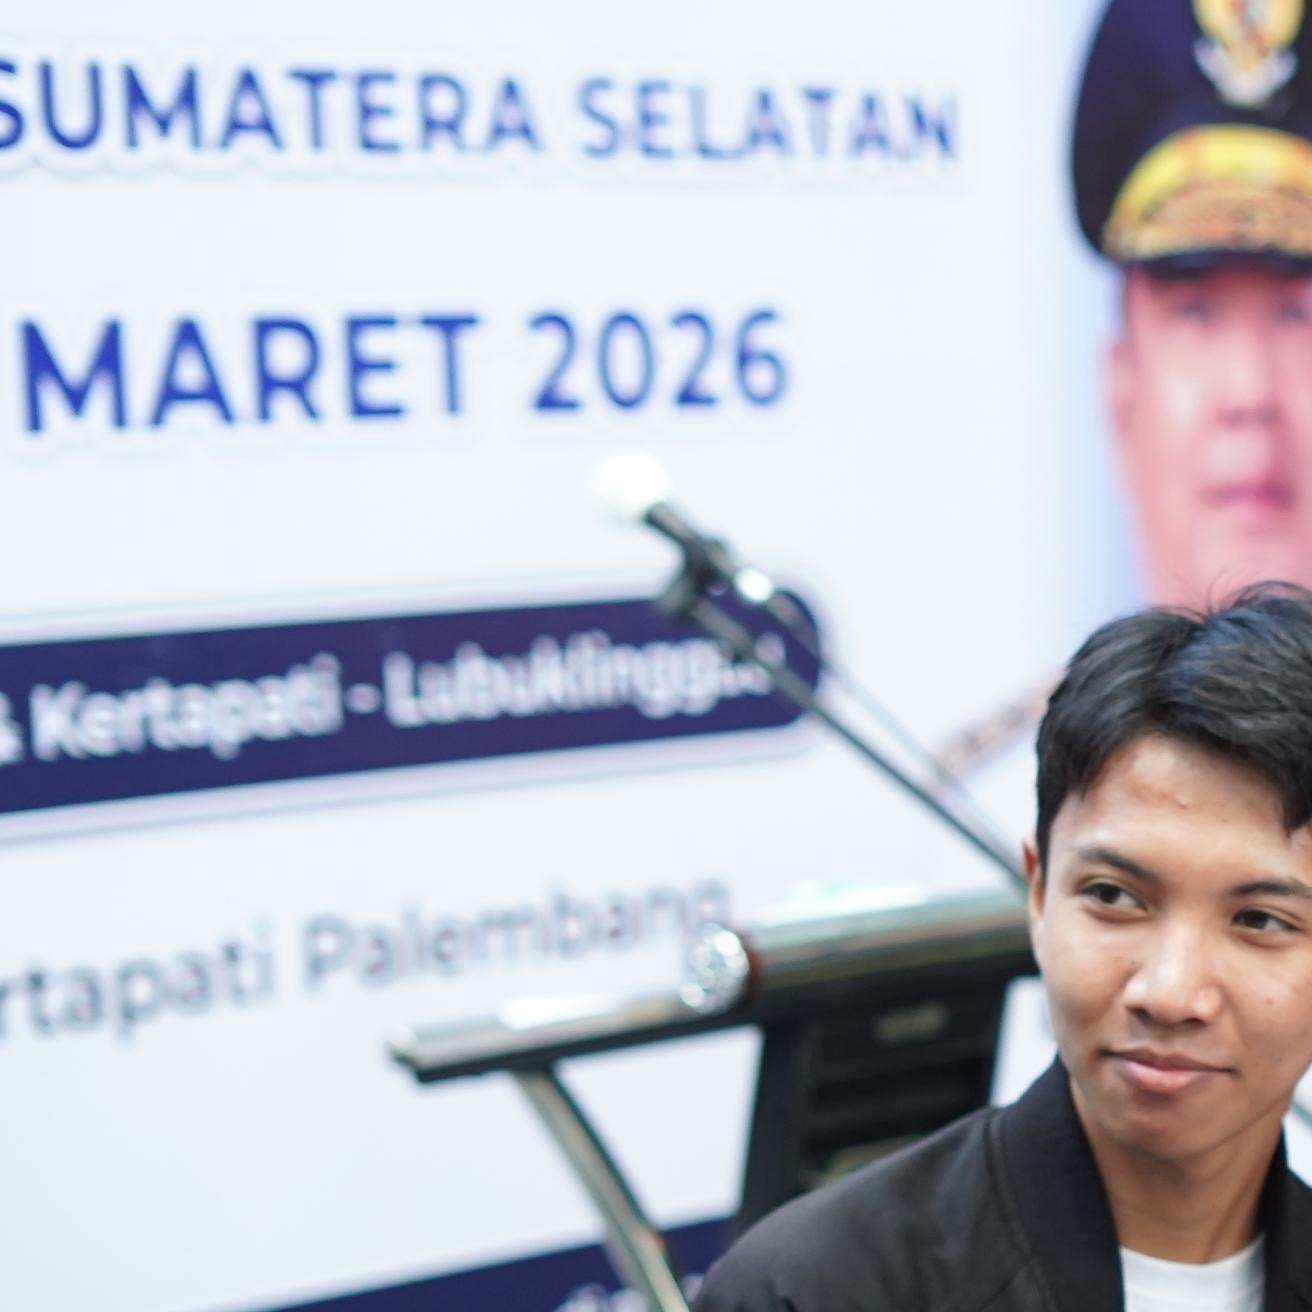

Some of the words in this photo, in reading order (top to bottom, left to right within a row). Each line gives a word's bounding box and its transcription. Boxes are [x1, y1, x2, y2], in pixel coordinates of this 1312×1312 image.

[0, 58, 541, 154] SUMATERA
[577, 77, 958, 161] SELATAN
[17, 314, 480, 433] MARET
[526, 309, 790, 412] 2026
[31, 653, 343, 762] Kertapati
